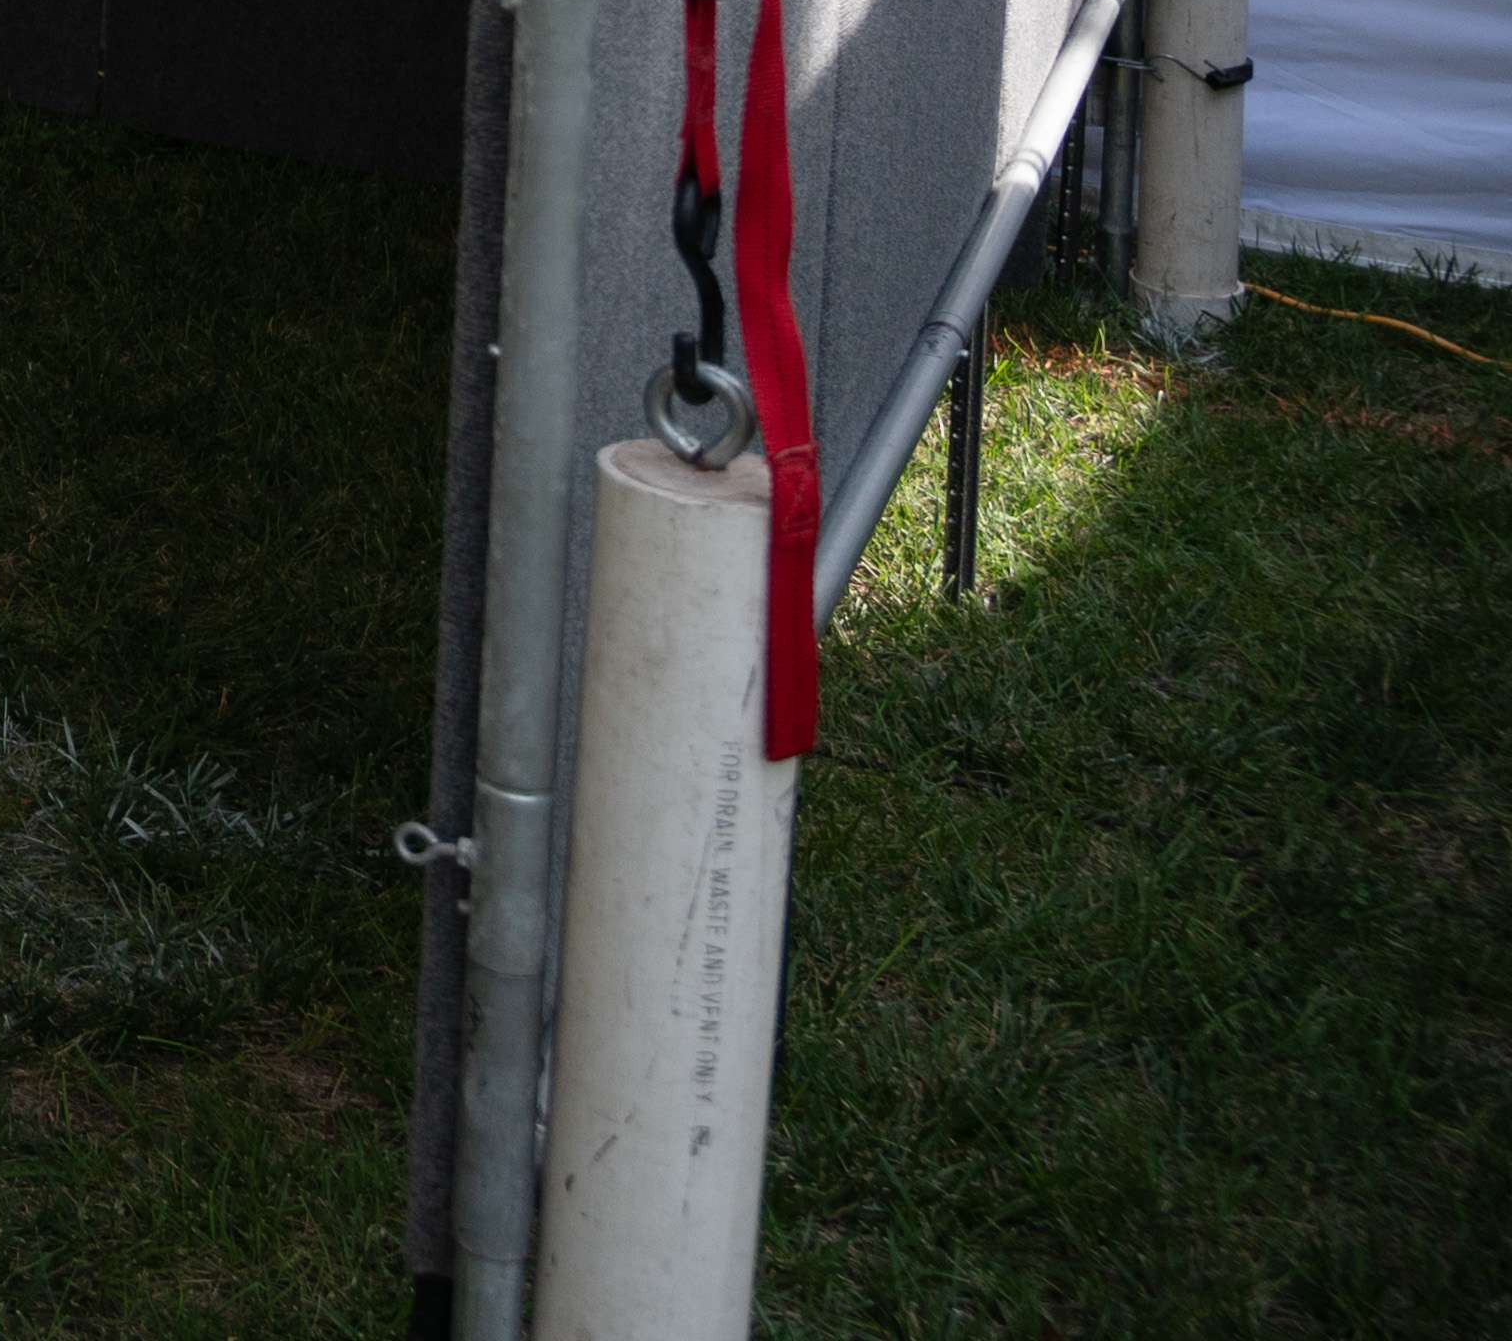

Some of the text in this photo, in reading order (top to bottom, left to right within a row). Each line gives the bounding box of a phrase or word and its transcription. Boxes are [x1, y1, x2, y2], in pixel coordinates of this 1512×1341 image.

[705, 868, 732, 936] WASTE
[701, 943, 727, 986] AND
[697, 990, 724, 1045] VENT
